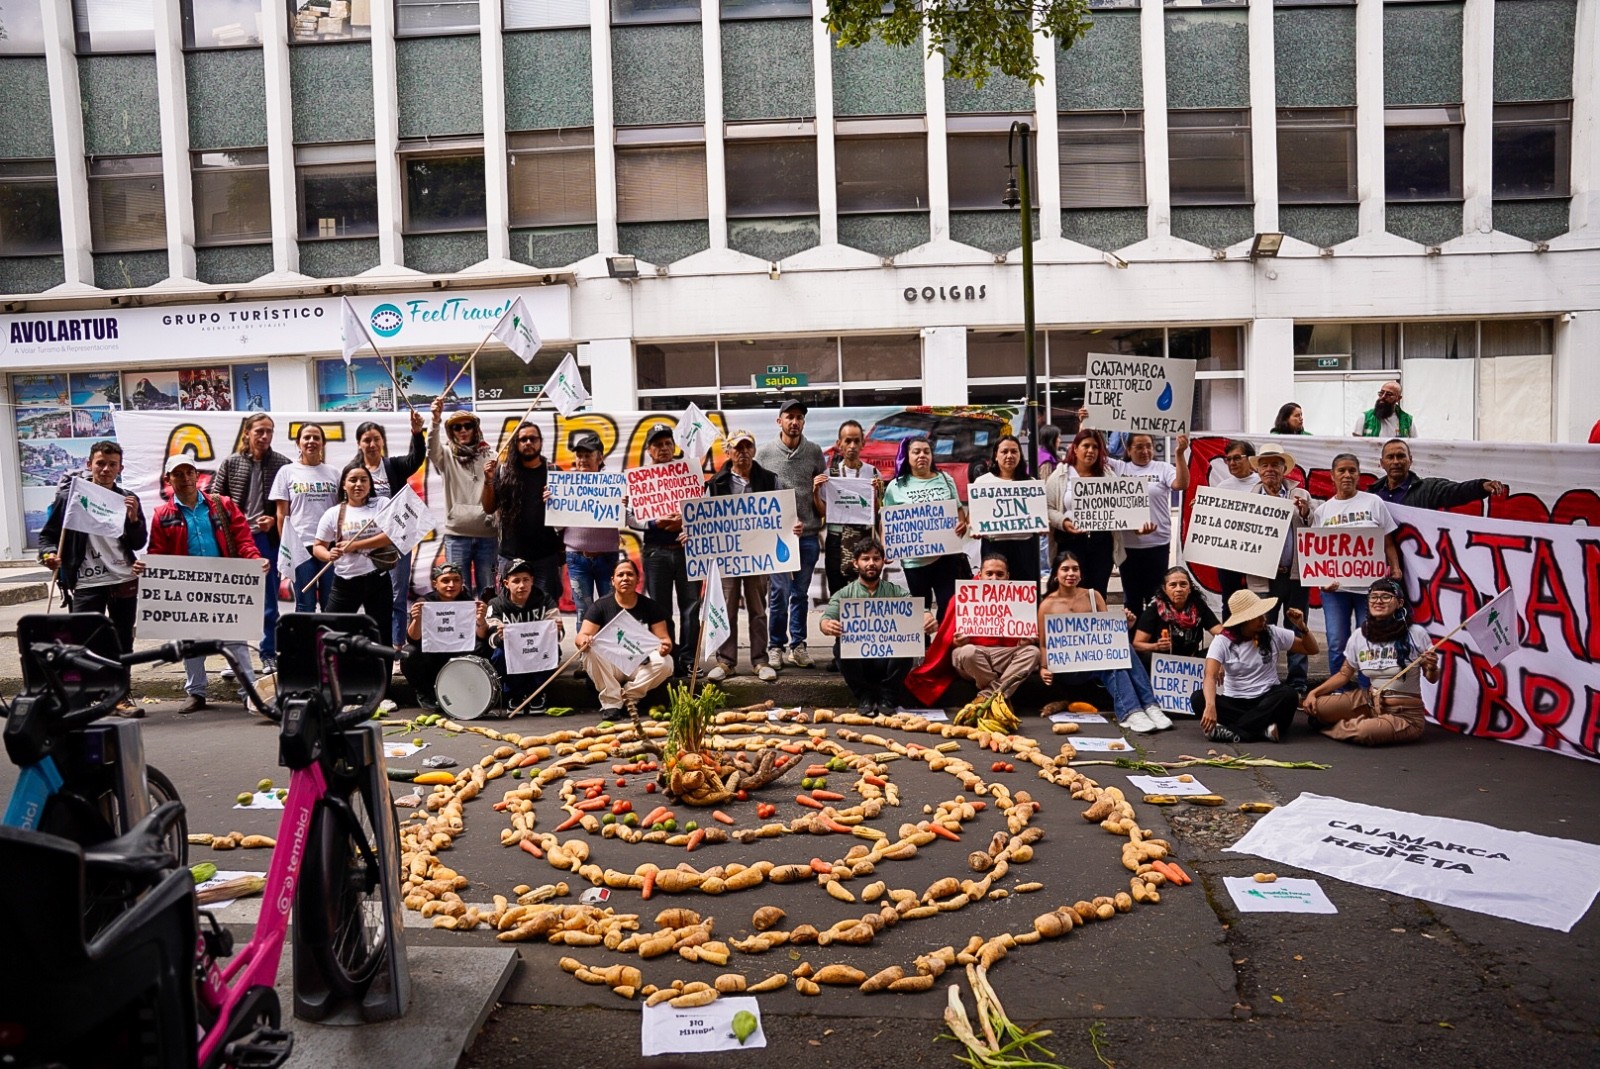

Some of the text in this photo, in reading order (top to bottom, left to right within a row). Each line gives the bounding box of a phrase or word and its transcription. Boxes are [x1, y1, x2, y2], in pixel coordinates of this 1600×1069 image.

[903, 284, 986, 302] COLGAS
[162, 307, 324, 326] GRUPO TURÍSTICO
[10, 317, 119, 344] AVOLARTUR
[1091, 360, 1165, 379] CAJAMARCA
[478, 389, 503, 399] 8-37
[1088, 378, 1153, 393] TERRITORIO
[1088, 391, 1123, 407] LIBRE
[1112, 409, 1127, 420] DE
[1130, 416, 1186, 433] MINERIA
[548, 473, 626, 486] IMPLEMENTACION
[628, 462, 689, 484] CAJAMARCA
[549, 486, 622, 498] DE LA CONSULTA
[629, 474, 700, 496] PARA PRODUCIR
[970, 486, 1046, 500] CAJAMARCA
[1074, 480, 1144, 497] CAJAMARCA
[632, 492, 669, 507] COMIDA
[671, 489, 685, 501] NO
[1073, 495, 1150, 511] INCONQUISTABLE
[1196, 494, 1291, 520] IMPLEMENTACIÓN
[547, 499, 620, 522] POPULAR ¡YA!
[636, 501, 679, 520] LA MINE
[684, 496, 781, 523] CAJAMARCA
[884, 505, 944, 522] CAJAMARCA
[992, 497, 1030, 518] SIN
[1074, 510, 1115, 521] REBELDE
[684, 515, 782, 537] INCONQUISTABLE
[979, 515, 1047, 533] MINERÍA
[1073, 520, 1128, 530] CAMPESINA
[1194, 514, 1279, 538] DE LA CONSULTA
[686, 534, 743, 557] REBELDE
[885, 532, 924, 547] REBELDE
[1191, 533, 1262, 554] POPULAR ¡YA!
[1298, 532, 1374, 557] ¡FUERA!
[885, 543, 945, 560] CAMPESINA
[141, 567, 260, 586] IMPLEMENTACIÓN
[1302, 559, 1386, 579] ANGLOGOLD
[142, 589, 254, 605] DE LA CONSULTA
[957, 581, 1037, 604] SI PARÁMOS
[142, 610, 239, 624] POPULAR ¡YA!
[841, 600, 913, 619] SI PARAMOS
[957, 604, 1013, 618] LA COLOSA
[958, 619, 1039, 637] CUALQUIER COSA
[962, 617, 1005, 627] PARAMOS
[1047, 617, 1128, 634] NO MAS PERMISOS
[841, 632, 921, 644] PARAMOS CUALQUIER
[1047, 633, 1113, 650] AMBIENTALES
[861, 642, 894, 657] COSA
[1047, 651, 1071, 666] PARA
[1155, 659, 1204, 679] CAJAMAR
[1153, 675, 1204, 694] LIBRE D
[1155, 694, 1195, 713] MINER
[287, 806, 309, 872] tembici
[1328, 820, 1511, 862] CAJAMARCA
[1386, 840, 1428, 852] SE
[1321, 835, 1474, 874] RESPETA
